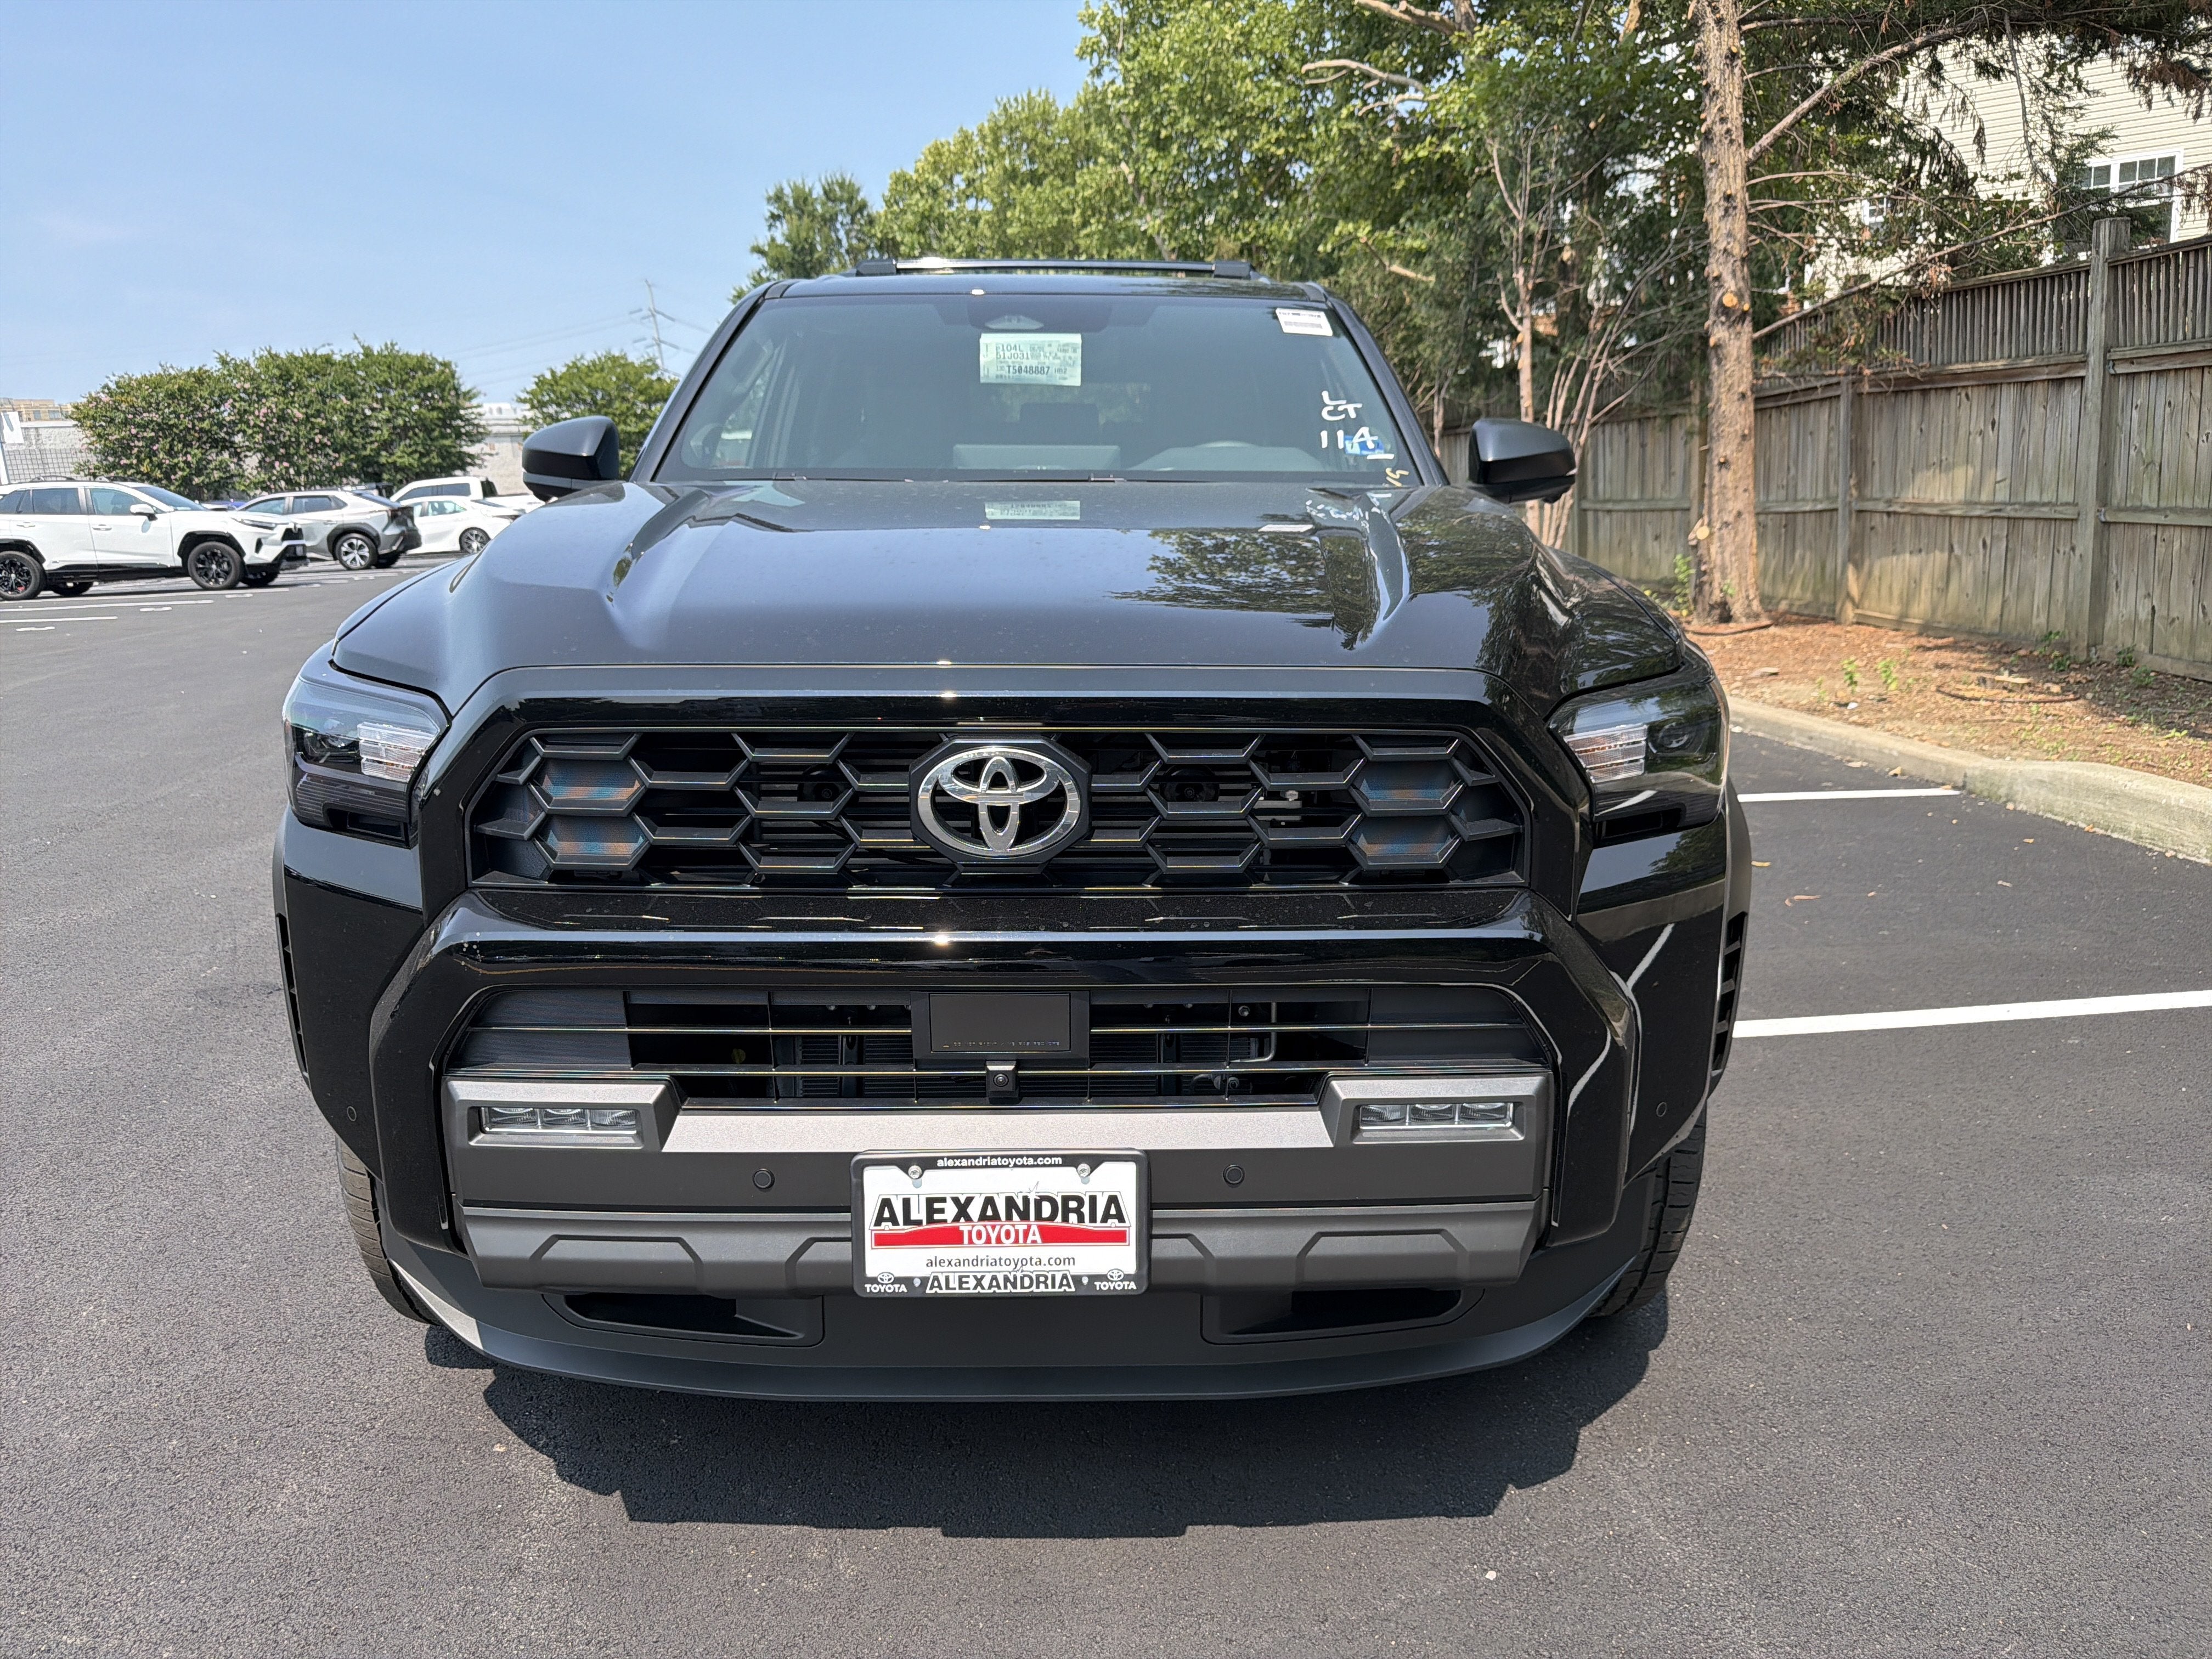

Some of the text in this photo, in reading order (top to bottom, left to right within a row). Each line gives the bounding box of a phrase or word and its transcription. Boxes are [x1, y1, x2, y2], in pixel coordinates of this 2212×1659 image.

[936, 1155, 1063, 1167] alexandriatoyota.com
[873, 1194, 1126, 1227] ALEXANDRIA
[959, 1224, 1042, 1245] TOYOTA
[926, 1255, 1076, 1269] alexandriatoyota.com
[865, 1284, 907, 1293] TOYOTA
[928, 1272, 1074, 1293] ALEXANDRIA
[1094, 1281, 1137, 1290] TOYOTA
